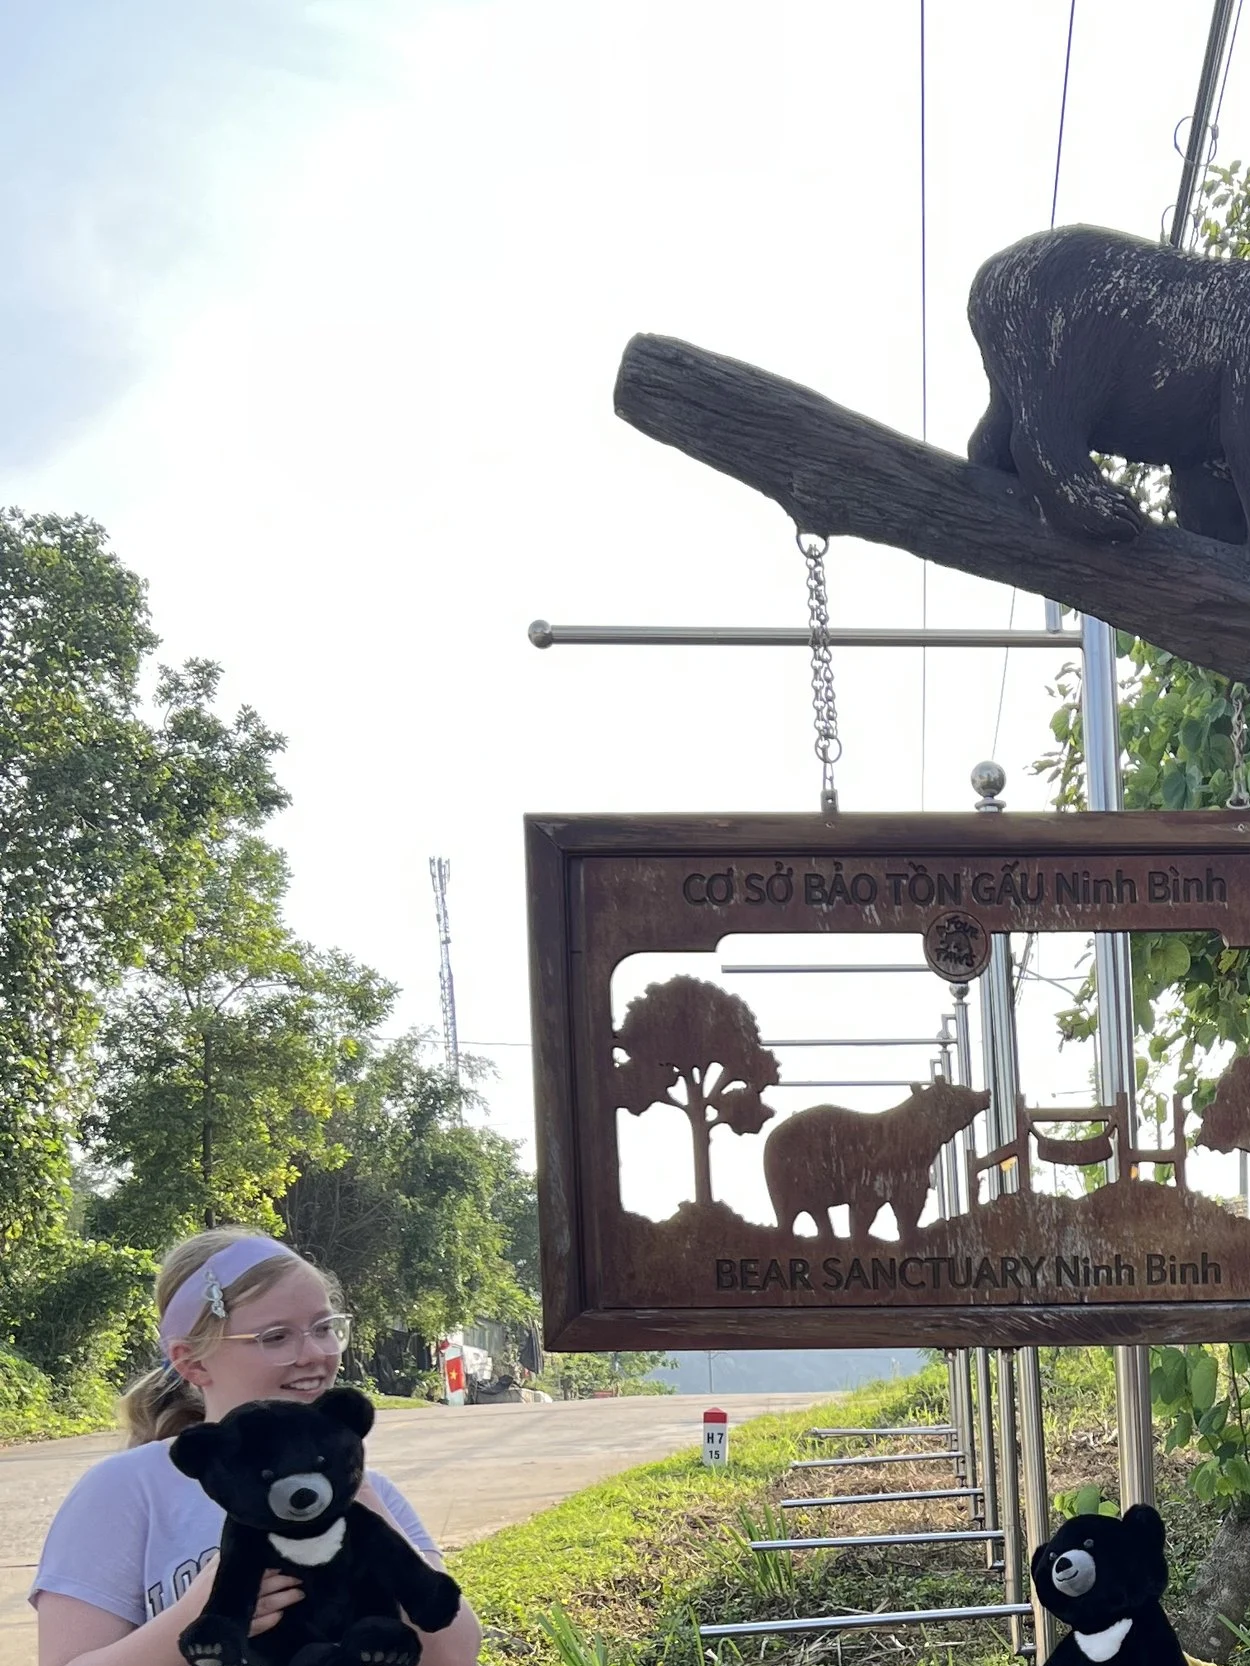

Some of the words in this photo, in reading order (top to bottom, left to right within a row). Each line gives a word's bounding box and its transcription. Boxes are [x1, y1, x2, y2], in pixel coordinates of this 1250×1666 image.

[682, 866, 735, 906] CƠ
[744, 860, 794, 906] SỞ
[803, 860, 878, 906] BẢO
[885, 860, 962, 907] TỒN
[971, 860, 1044, 906] GẤU
[1055, 869, 1138, 905] Ninh
[1148, 865, 1228, 904] Bình
[715, 1258, 814, 1292] BEAR
[822, 1256, 1050, 1291] SANCTUARY
[1055, 1254, 1136, 1288] Ninh
[1146, 1252, 1222, 1286] Binh
[709, 1450, 720, 1460] 15
